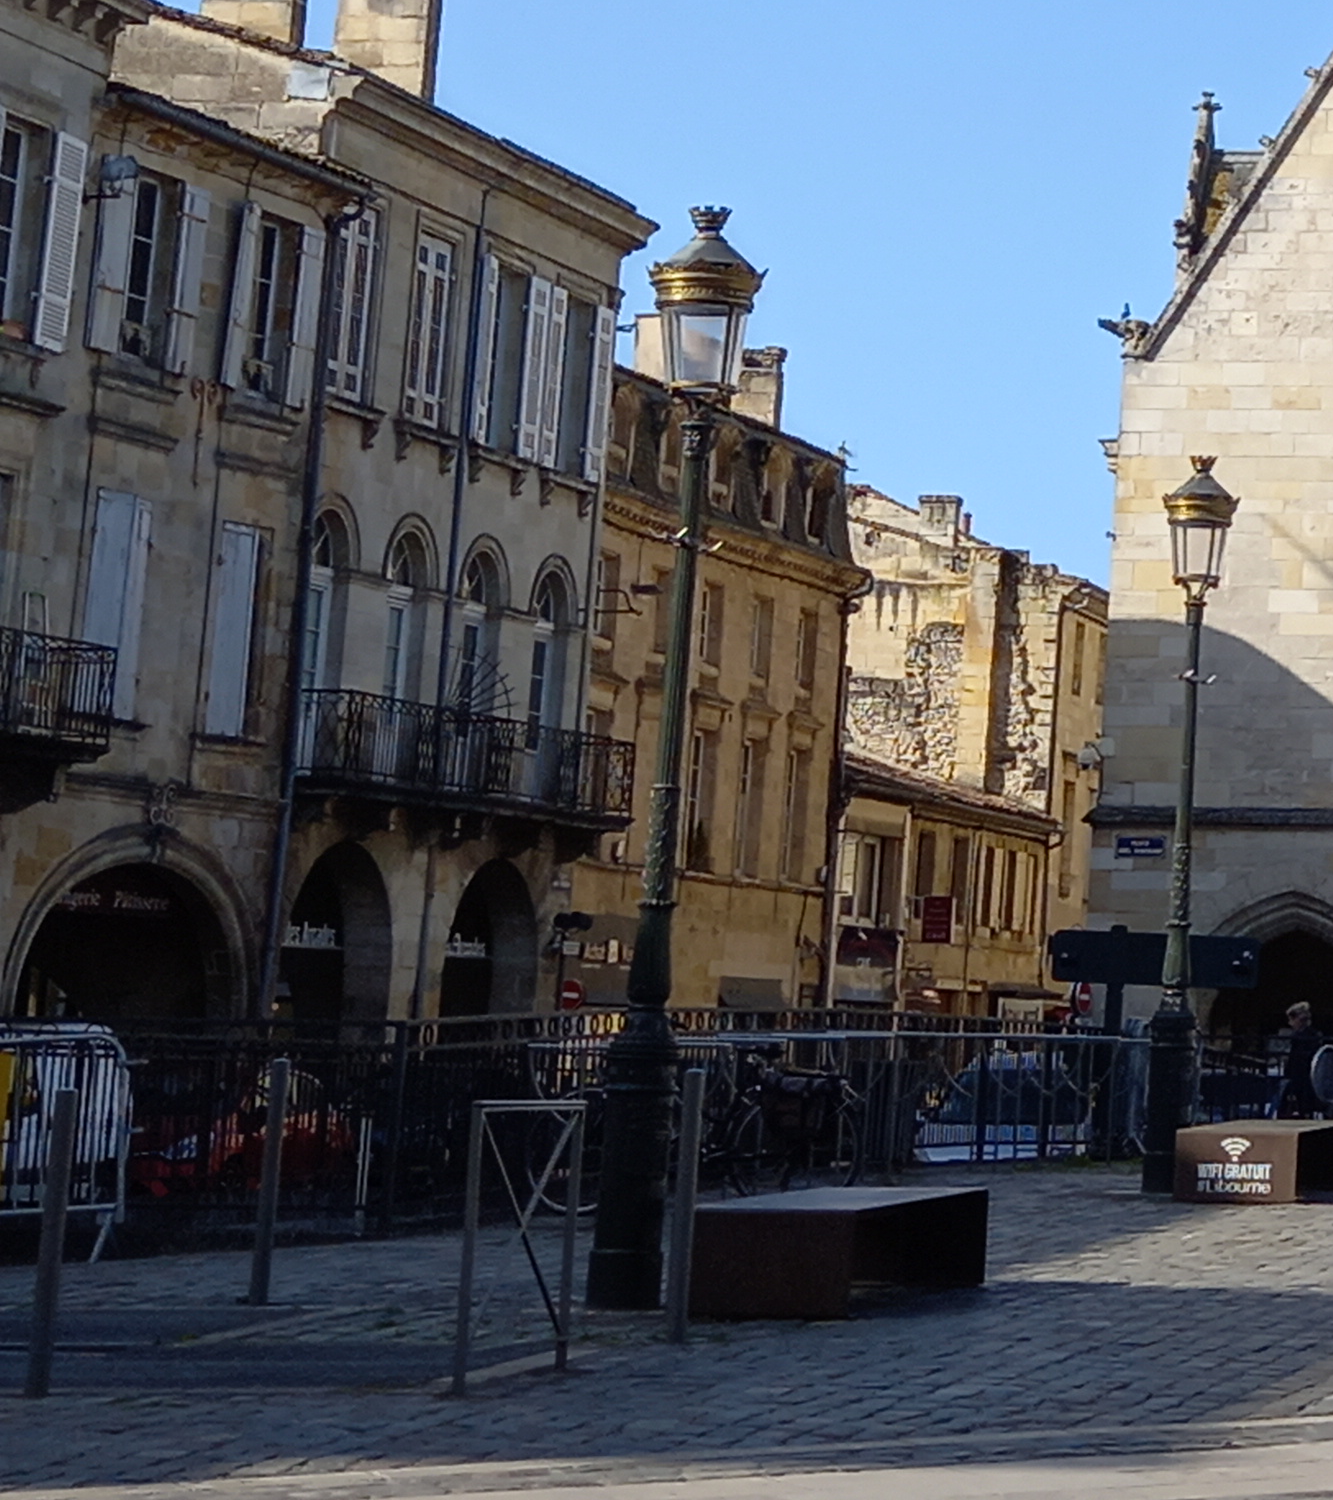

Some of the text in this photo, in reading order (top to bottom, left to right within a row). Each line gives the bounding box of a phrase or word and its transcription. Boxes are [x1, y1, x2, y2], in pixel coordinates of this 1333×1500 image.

[1197, 1163, 1272, 1180] WIFI GRATUIT
[1197, 1179, 1272, 1195] #Libourne
